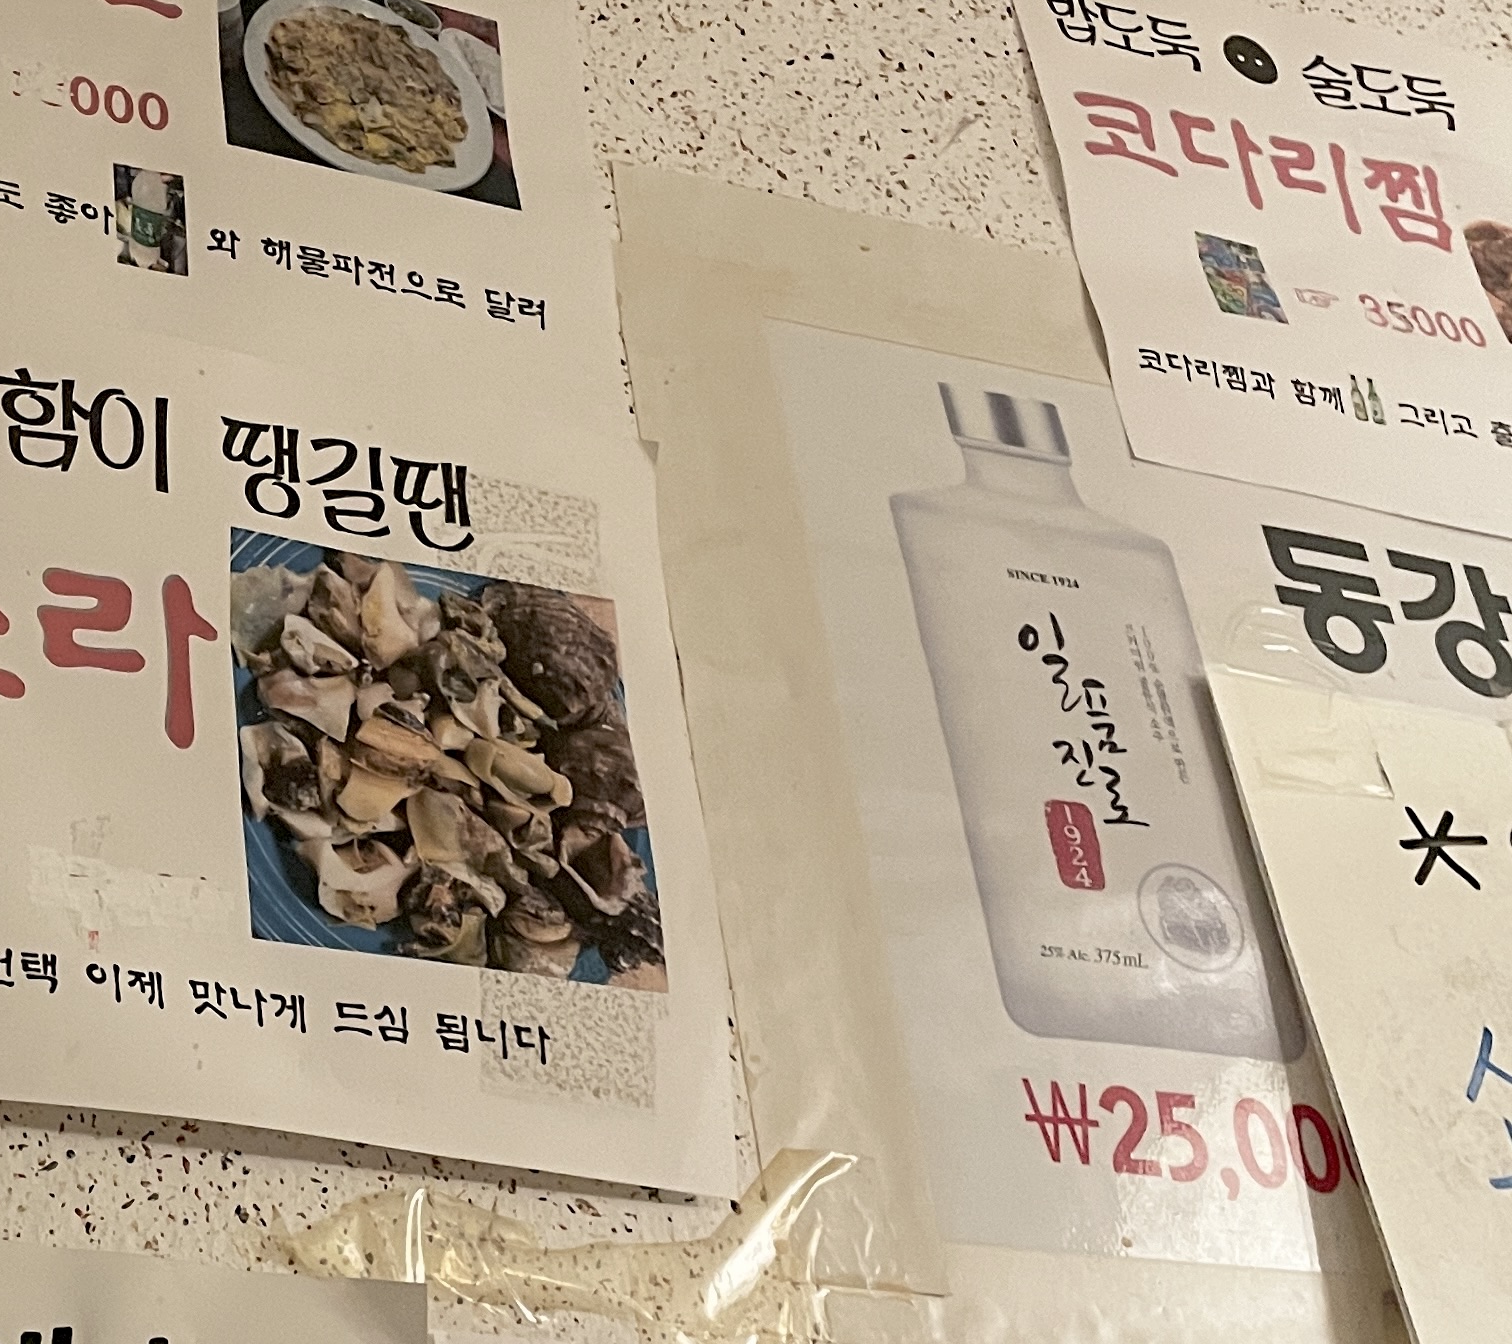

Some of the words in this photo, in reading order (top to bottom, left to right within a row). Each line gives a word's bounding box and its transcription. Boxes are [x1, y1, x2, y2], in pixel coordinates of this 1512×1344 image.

[13, 70, 169, 131] 000
[1302, 55, 1455, 131] 술도둑
[1073, 91, 1455, 253] 코다리찜
[44, 192, 114, 235] 좋아
[207, 229, 240, 259] 와
[261, 237, 466, 309] 해물파전으로
[485, 289, 545, 330] 달려
[1359, 294, 1486, 347] 35000
[1139, 348, 1275, 400] 코다리찜과
[1291, 378, 1345, 414] 함께
[1398, 403, 1479, 438] 그리고
[220, 416, 474, 553] 땡길땐
[1007, 569, 1050, 583] SINCE
[1052, 573, 1080, 589] 1924
[86, 964, 164, 1009] 이제
[189, 980, 306, 1033] 맛나게
[334, 1002, 409, 1044] 드심
[436, 1011, 552, 1067] 됩니다
[1021, 1077, 1362, 1202] ₩25,00
